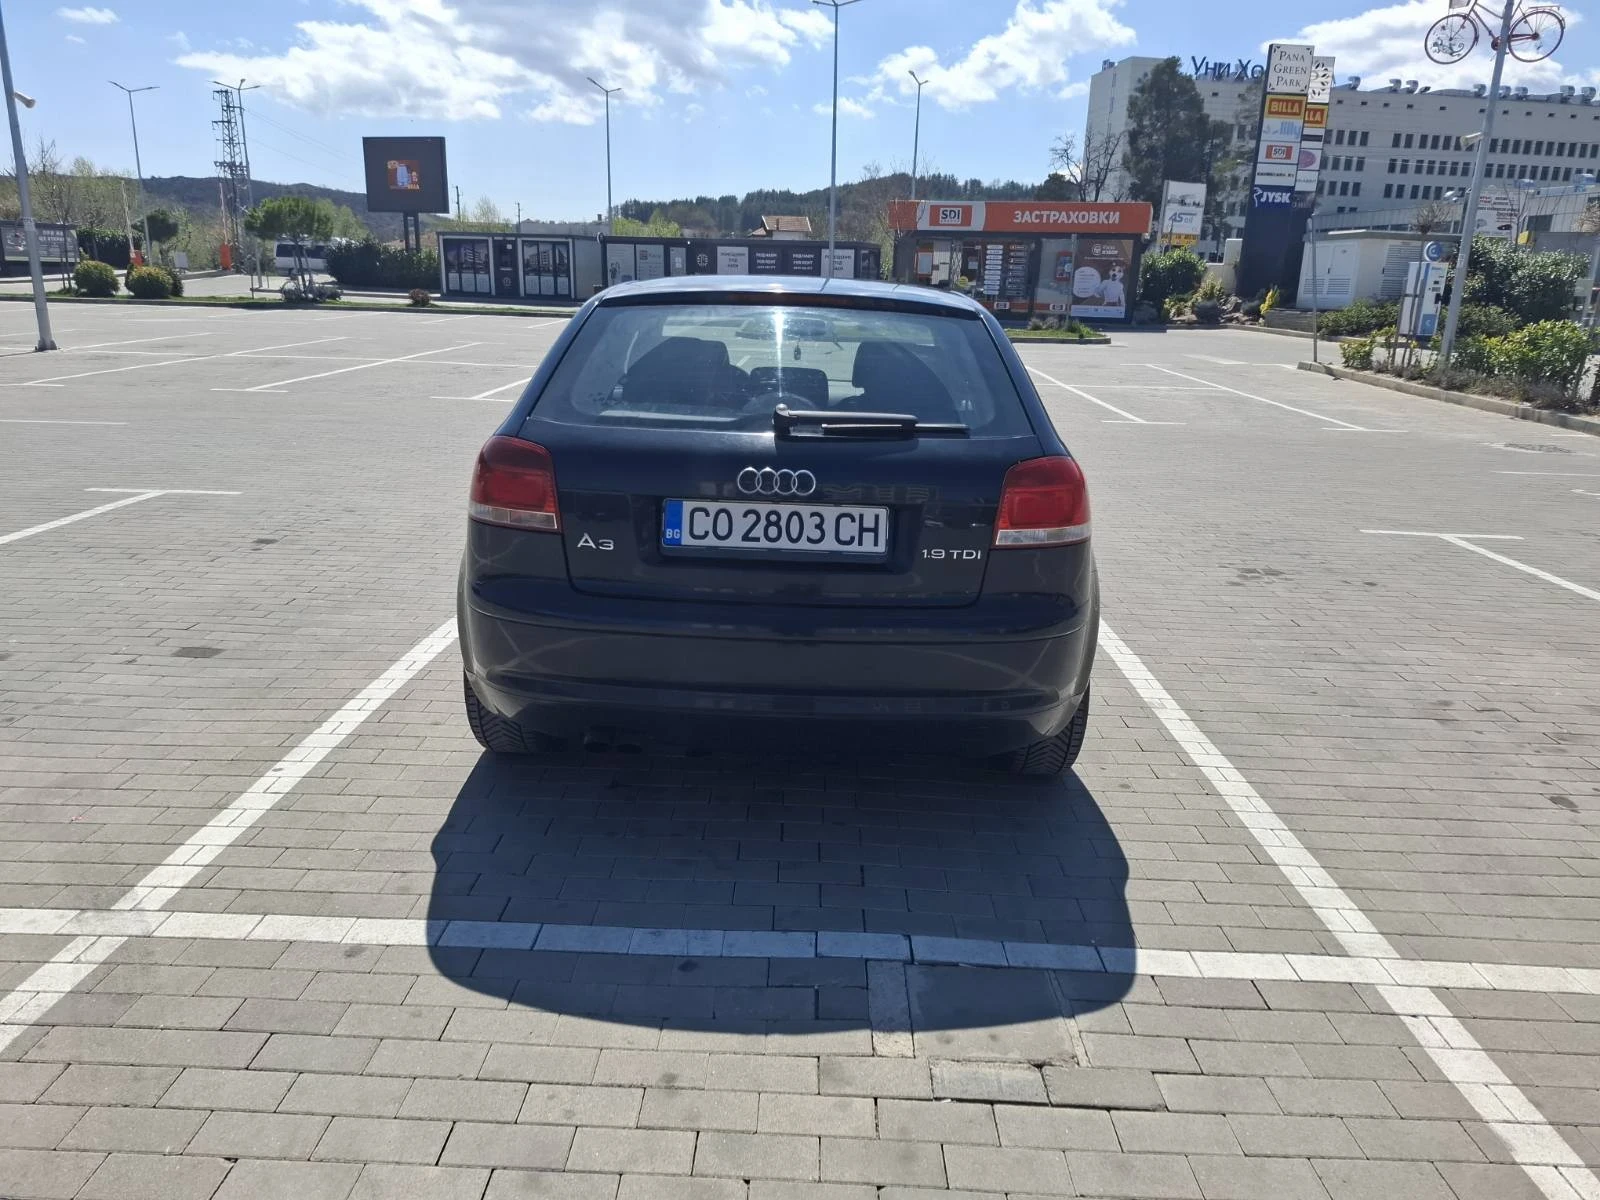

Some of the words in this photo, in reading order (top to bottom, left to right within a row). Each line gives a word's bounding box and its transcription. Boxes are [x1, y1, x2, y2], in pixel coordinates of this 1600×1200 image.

[1280, 51, 1305, 62] PANA
[1274, 63, 1307, 75] GREEN
[1276, 76, 1302, 87] PARK
[1271, 101, 1300, 113] BILLA
[1305, 110, 1321, 122] LLA
[1260, 191, 1291, 204] JYSK
[941, 209, 961, 219] SDI
[1013, 210, 1120, 225] ЗАСТРАХОВКИ
[666, 529, 680, 539] BG
[741, 509, 826, 544] 2803
[834, 512, 880, 547] CH
[577, 532, 614, 550] A3
[922, 549, 945, 559] 1.9
[949, 549, 981, 560] TDI
